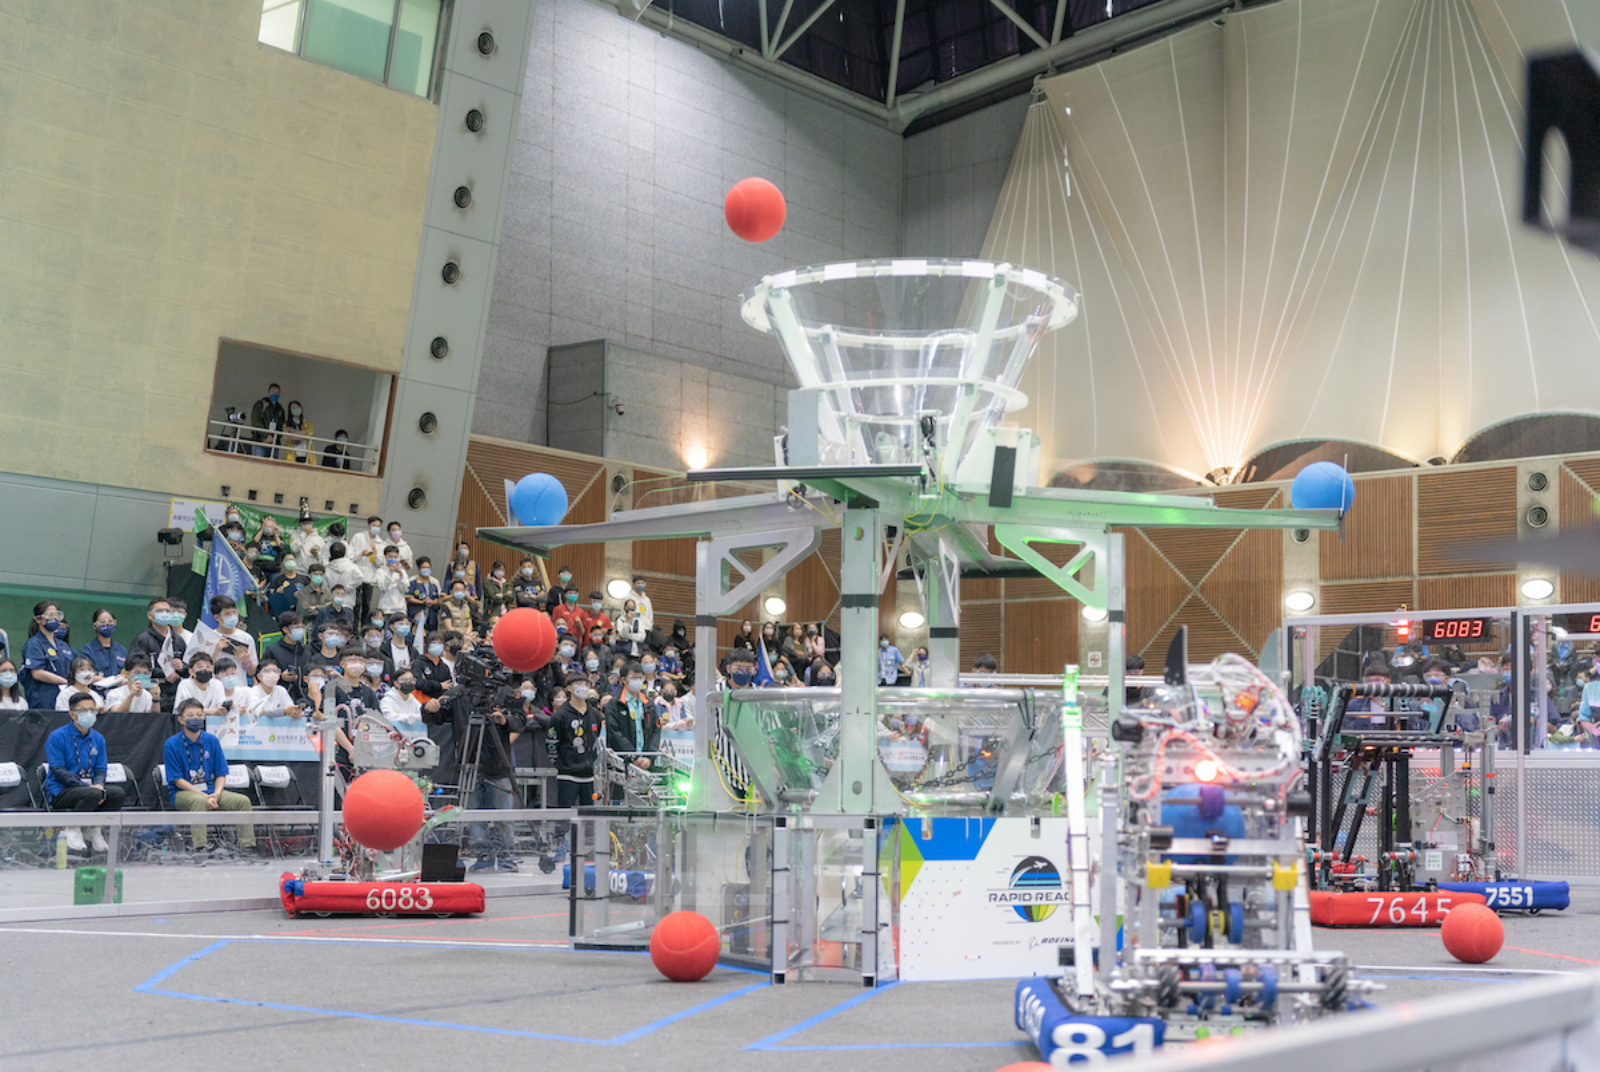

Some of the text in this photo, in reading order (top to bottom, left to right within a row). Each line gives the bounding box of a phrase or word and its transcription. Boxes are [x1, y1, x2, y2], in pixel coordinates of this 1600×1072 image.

[1434, 619, 1483, 639] 6083
[366, 887, 434, 911] 6083
[988, 891, 1070, 902] RAPID REAC
[1485, 886, 1534, 907] 7551
[1367, 896, 1452, 924] 7645
